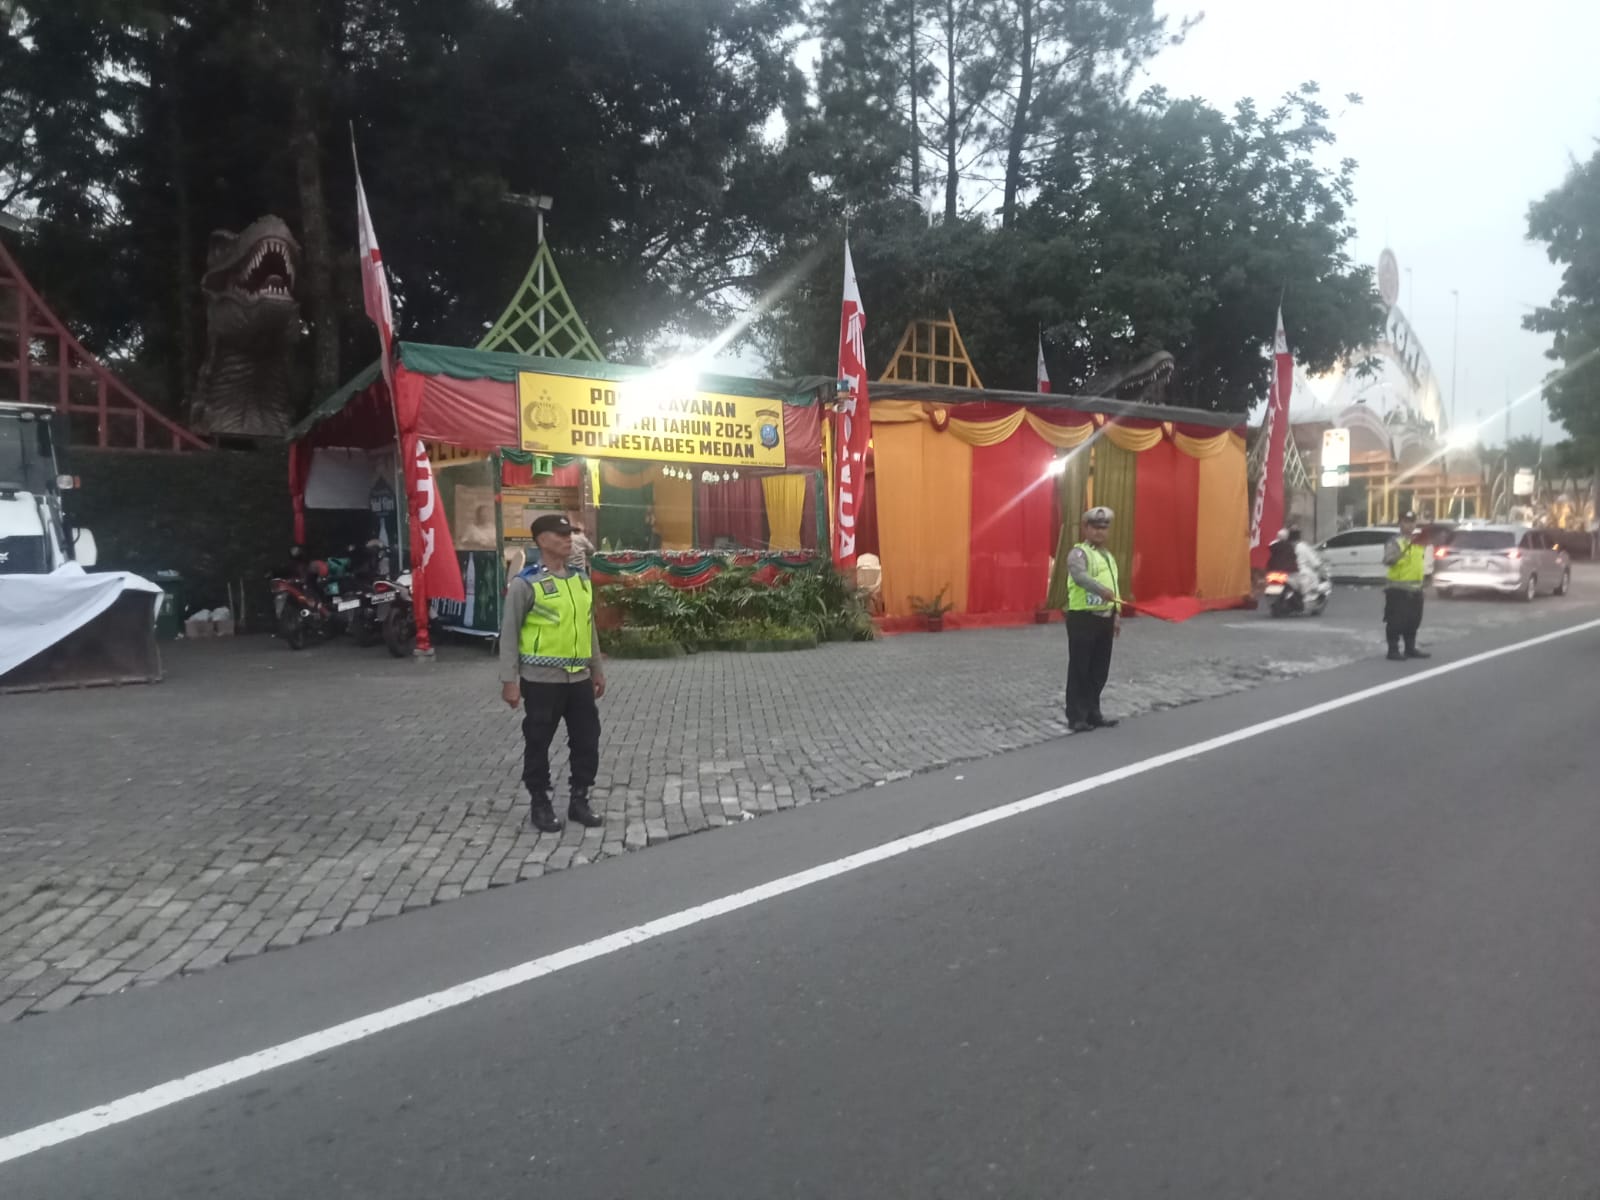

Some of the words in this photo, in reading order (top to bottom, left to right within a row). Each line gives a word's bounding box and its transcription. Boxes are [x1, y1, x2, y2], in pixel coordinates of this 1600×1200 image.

[590, 388, 621, 406] PO
[571, 408, 610, 428] IDUL
[615, 413, 656, 431] FRI
[662, 417, 711, 436] TAHUN
[715, 422, 753, 440] 2025
[571, 429, 695, 455] POLRESTABES
[699, 440, 755, 459] MEDAN
